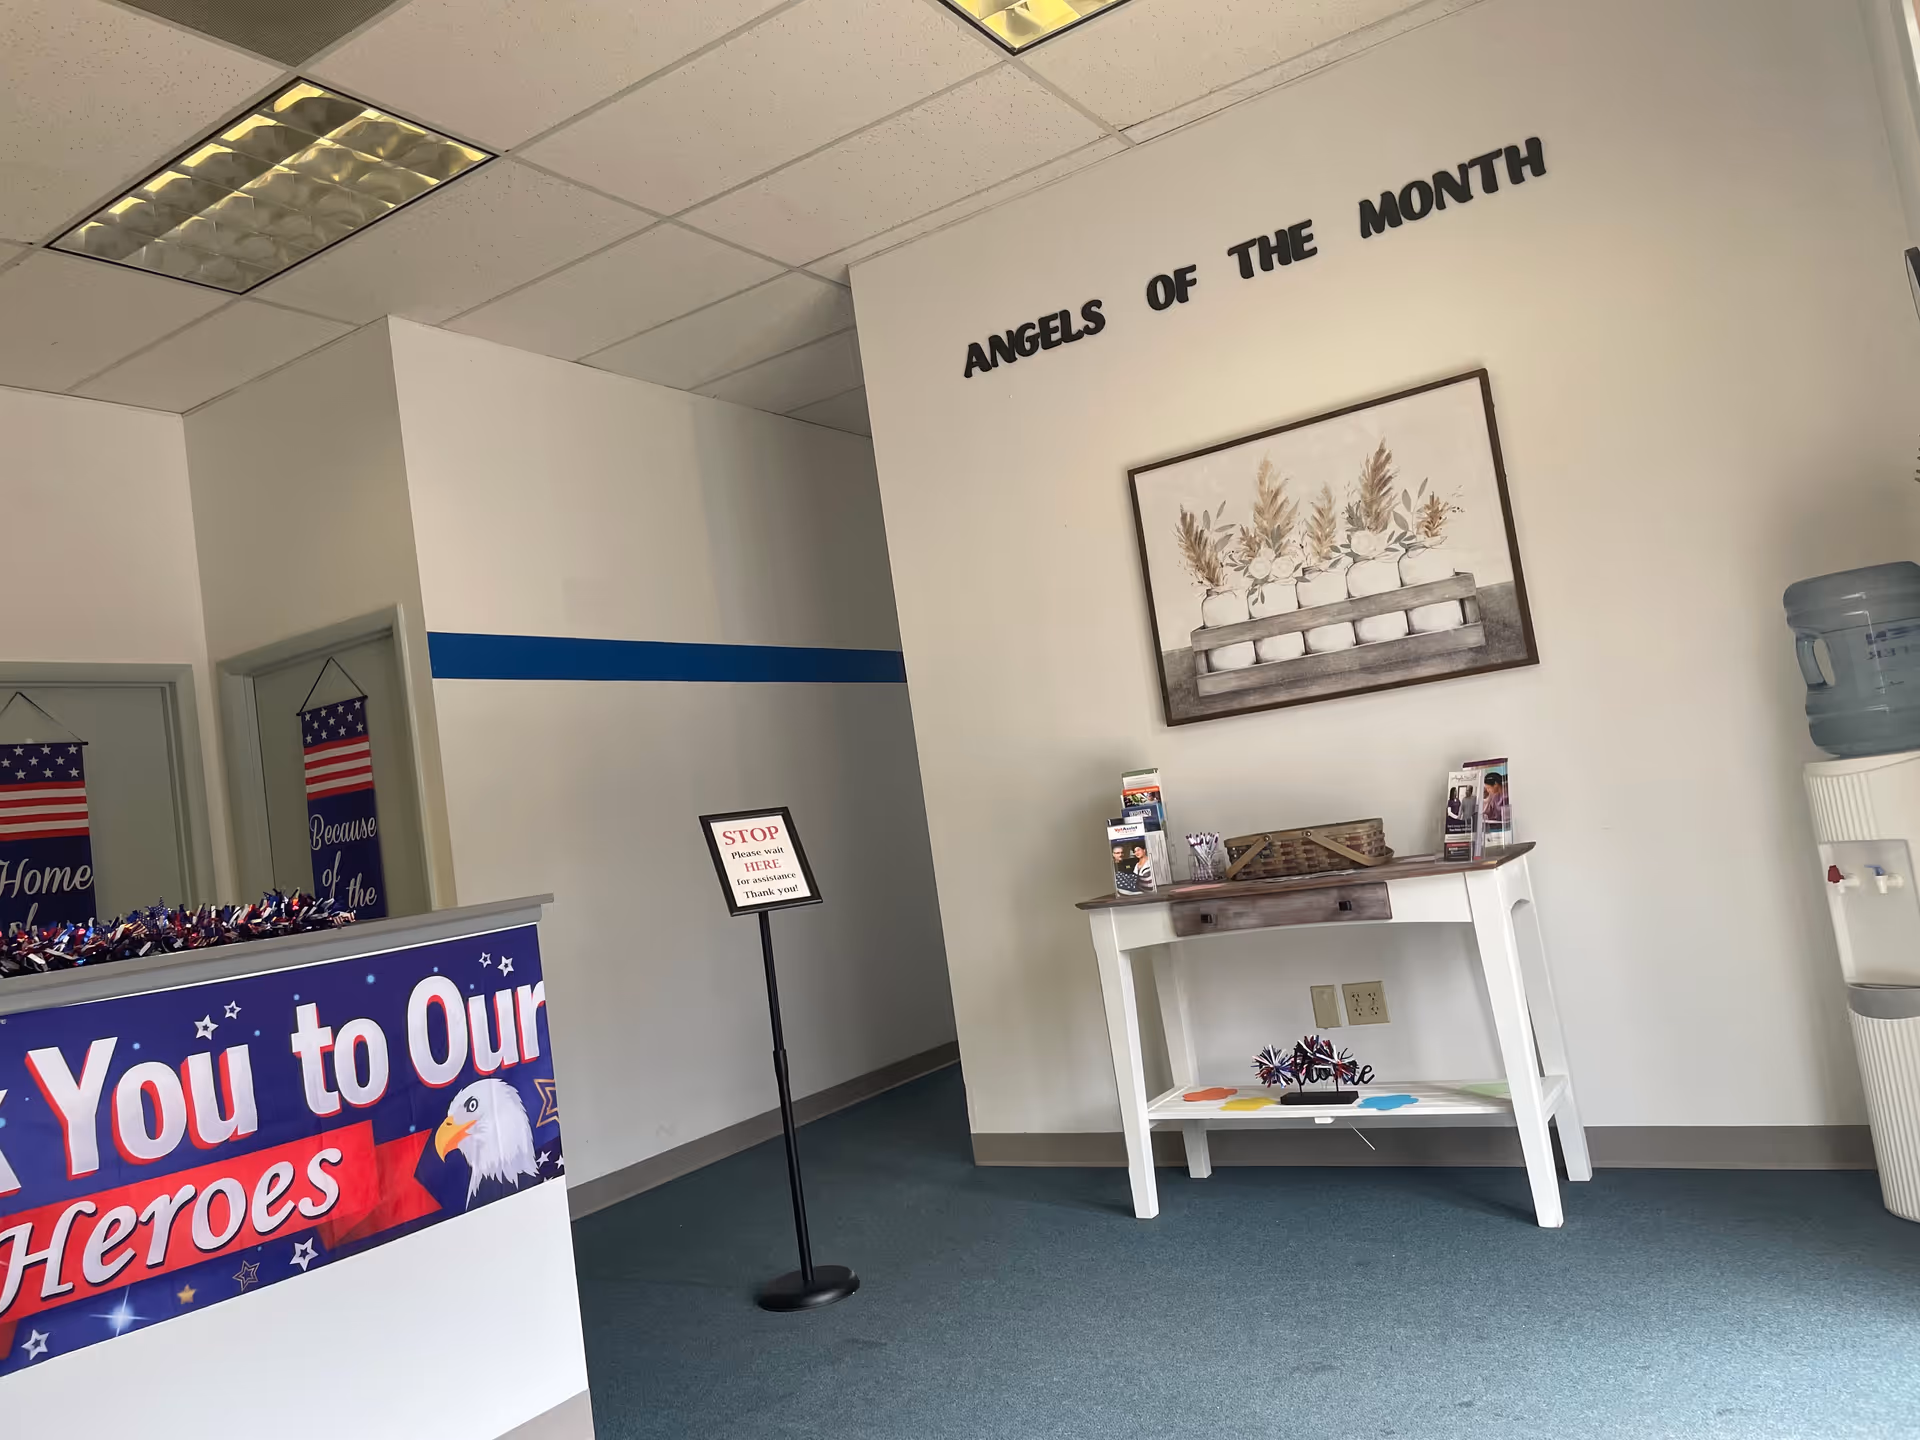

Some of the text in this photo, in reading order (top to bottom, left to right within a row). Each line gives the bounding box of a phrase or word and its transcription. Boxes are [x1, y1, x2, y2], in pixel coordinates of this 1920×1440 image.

[964, 137, 1546, 378] ANGELS OF THE MONTH
[309, 813, 377, 851] Because
[722, 825, 779, 846] STOP
[731, 846, 784, 860] Please wait
[744, 859, 781, 872] HERE
[0, 858, 94, 898] Home
[322, 850, 342, 899] of
[346, 872, 377, 908] the
[736, 872, 797, 886] for assistance
[743, 884, 799, 899] Thank you!
[25, 1037, 259, 1180] You
[290, 1002, 390, 1118] to
[405, 975, 546, 1088] Our
[0, 1147, 344, 1316] Heroes
